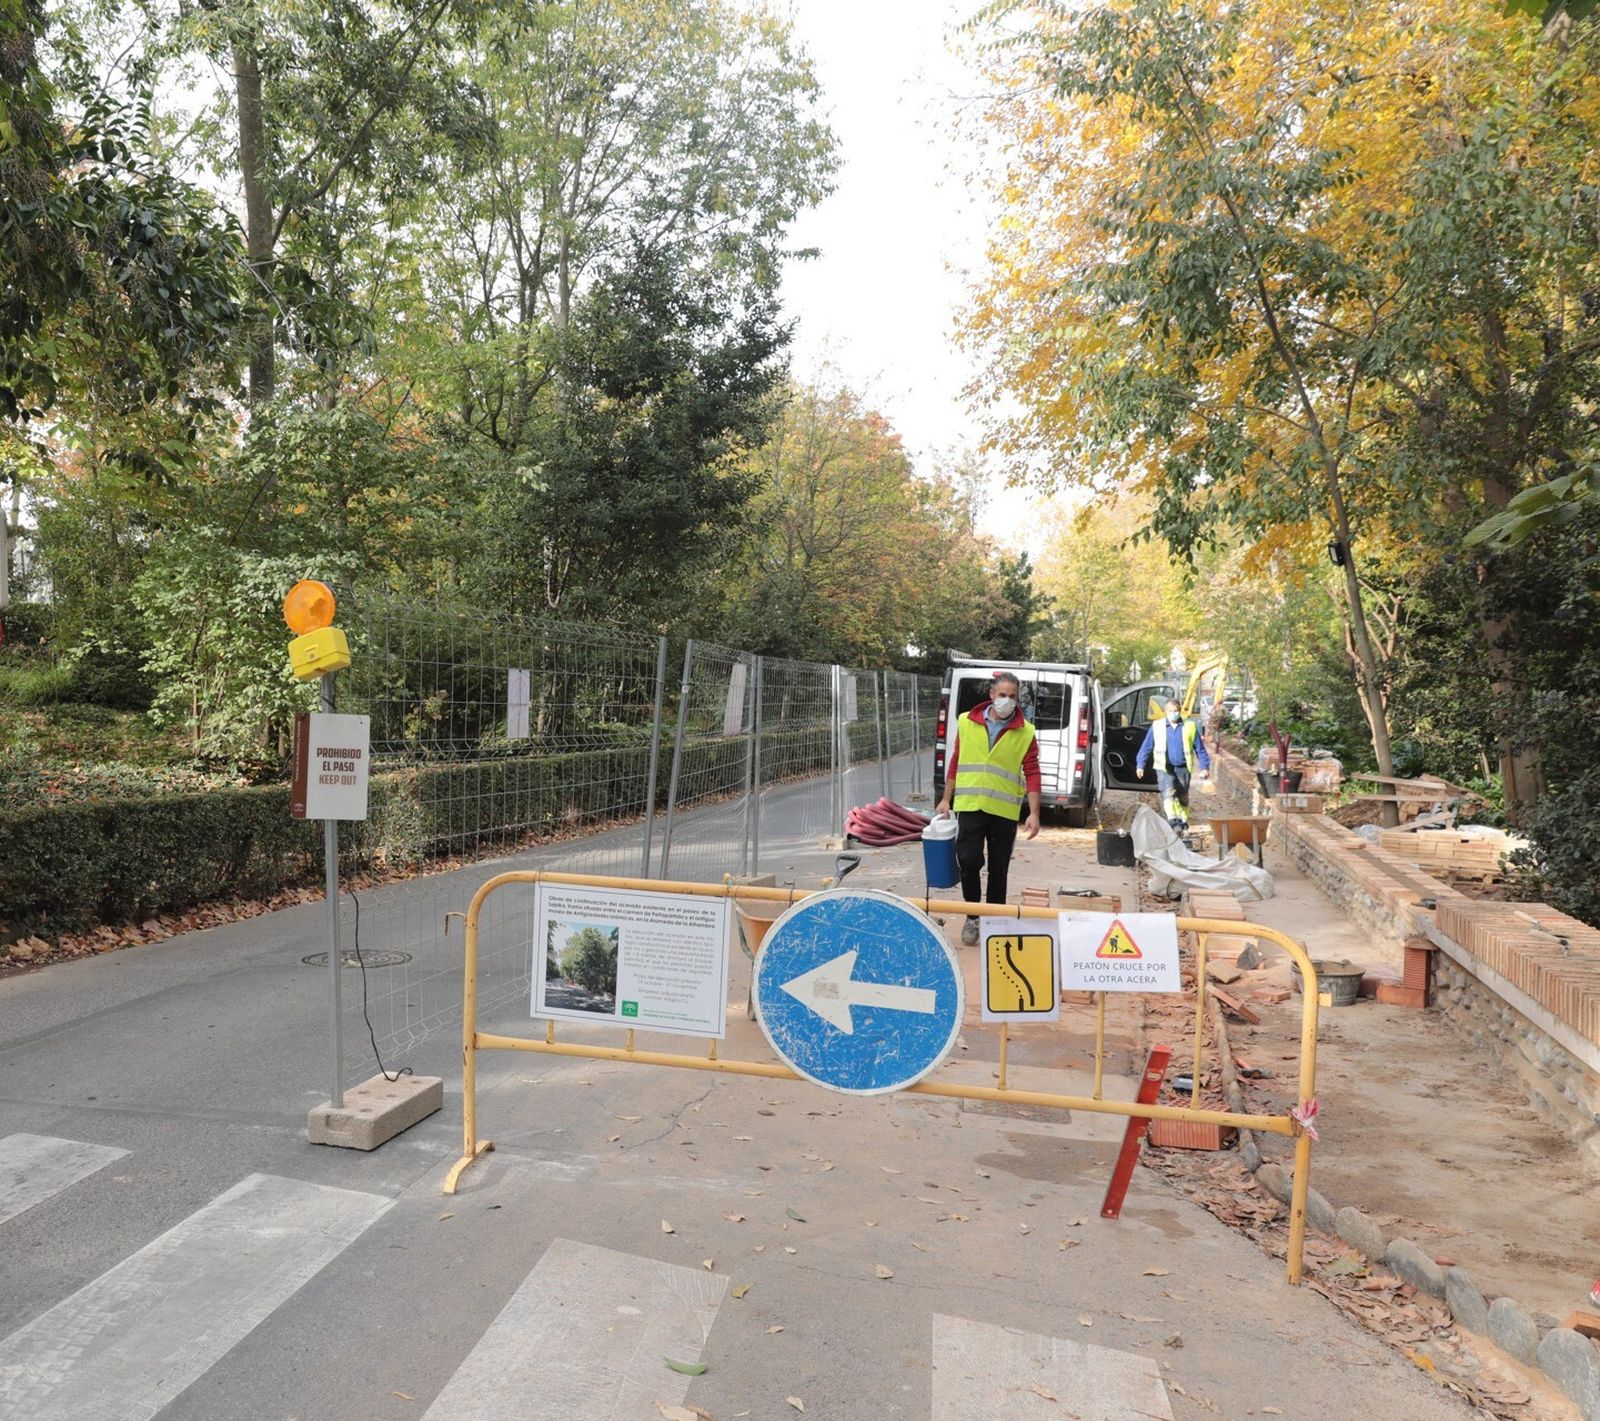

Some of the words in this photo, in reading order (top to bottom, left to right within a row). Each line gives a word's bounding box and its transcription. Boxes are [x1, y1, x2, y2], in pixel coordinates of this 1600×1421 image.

[316, 747, 362, 760] PROHIBIDO
[322, 760, 332, 772] EL
[333, 761, 355, 773] PASO
[319, 774, 340, 785] KEEP
[340, 775, 357, 786] OUT
[574, 911, 609, 919] Antigüedades
[1113, 962, 1144, 971] CRUCE
[1147, 963, 1167, 972] POR
[1083, 975, 1096, 984] LA
[1098, 975, 1124, 984] OTRA
[1126, 975, 1158, 984] ACERA
